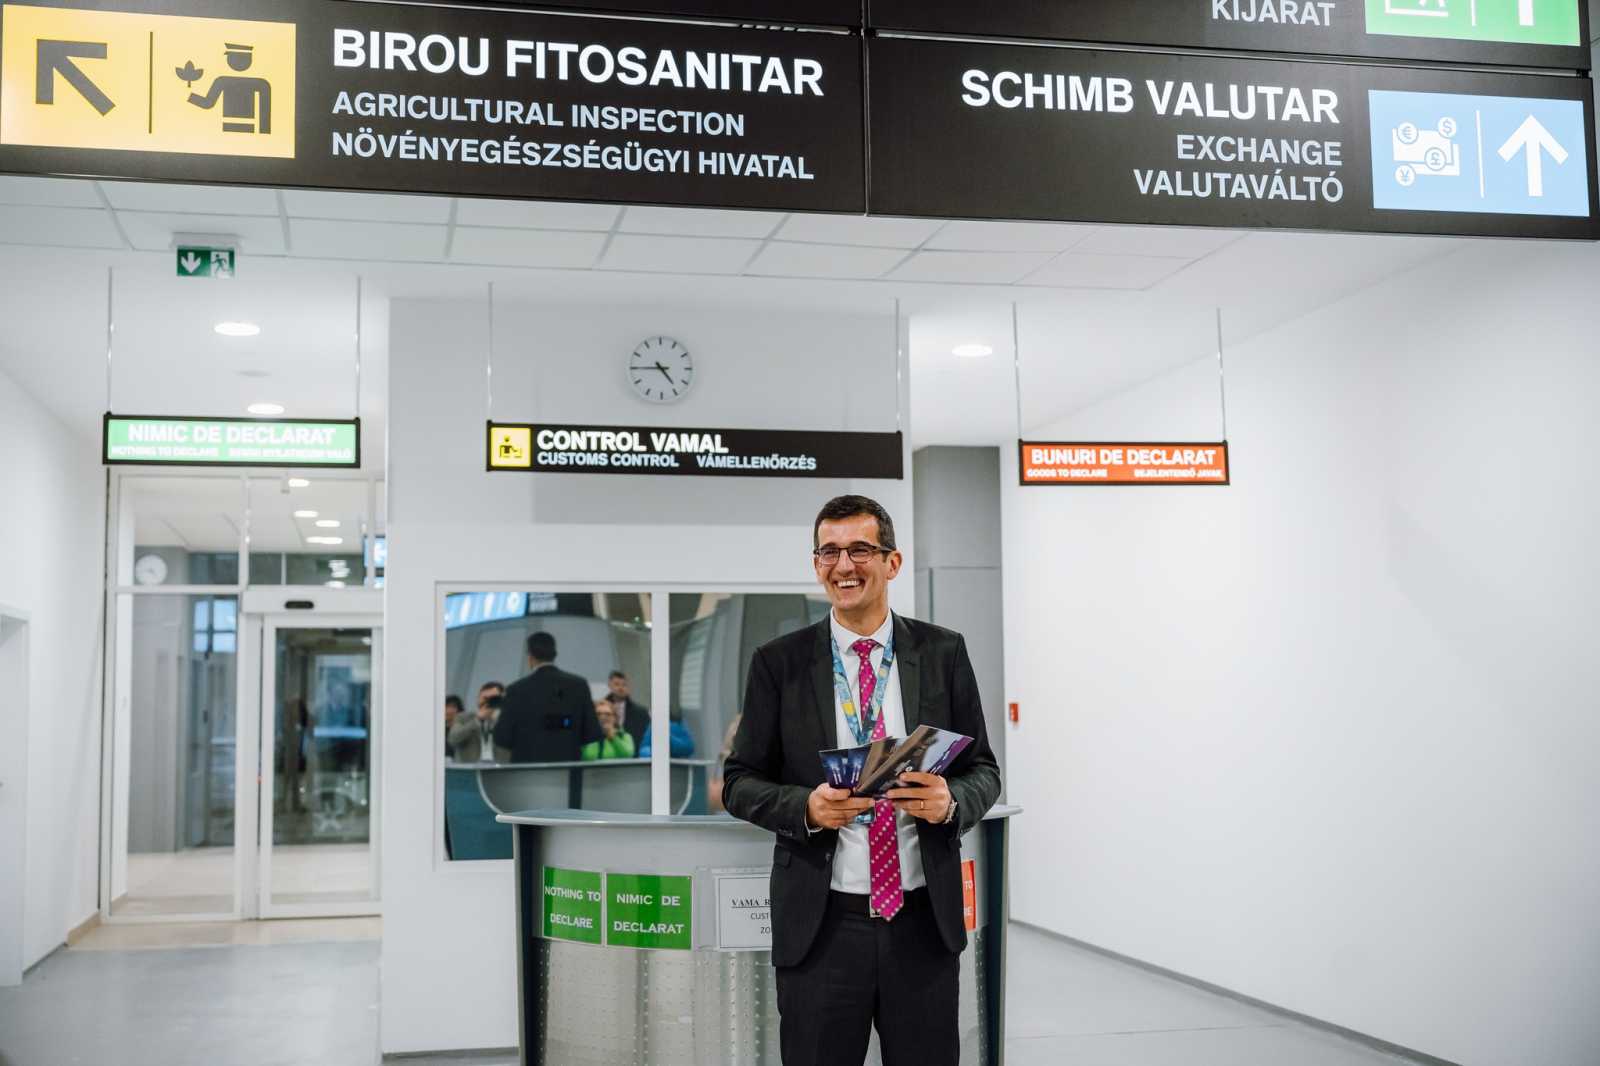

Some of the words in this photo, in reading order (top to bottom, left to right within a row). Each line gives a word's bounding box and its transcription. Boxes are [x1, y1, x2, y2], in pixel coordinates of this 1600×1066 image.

[333, 28, 490, 76] BIROU
[506, 39, 825, 97] FITOSANITAR
[961, 69, 1135, 113] SCHIMB
[1145, 79, 1340, 124] VALUTAR
[332, 90, 564, 126] AGRICULTURAL
[571, 104, 745, 137] INSPECTION
[332, 127, 690, 174] NÖVÉNYEGÉSZSÉGÜGYI
[699, 151, 815, 180] HIVATAL
[1176, 134, 1343, 166] EXCHANGE
[1133, 168, 1344, 203] VALUTAVÁLTÓ
[127, 423, 191, 442] NIMIC
[192, 424, 222, 443] DE
[226, 425, 336, 445] DECLARAT
[537, 429, 647, 452] CONTROL
[650, 432, 729, 454] VAMAL
[537, 451, 609, 466] CUSTOMS
[610, 453, 680, 468] CONTROL
[1031, 448, 1096, 465] BUNURI
[1100, 448, 1123, 465] DE
[1126, 449, 1216, 465] DECLARAT
[544, 886, 583, 900] NOTHING
[587, 891, 602, 902] TO
[616, 893, 653, 905] NIMIC
[661, 895, 681, 906] DE
[731, 898, 760, 907] VAMA
[550, 913, 593, 929] DECLARE
[613, 920, 685, 934] DECLARAT
